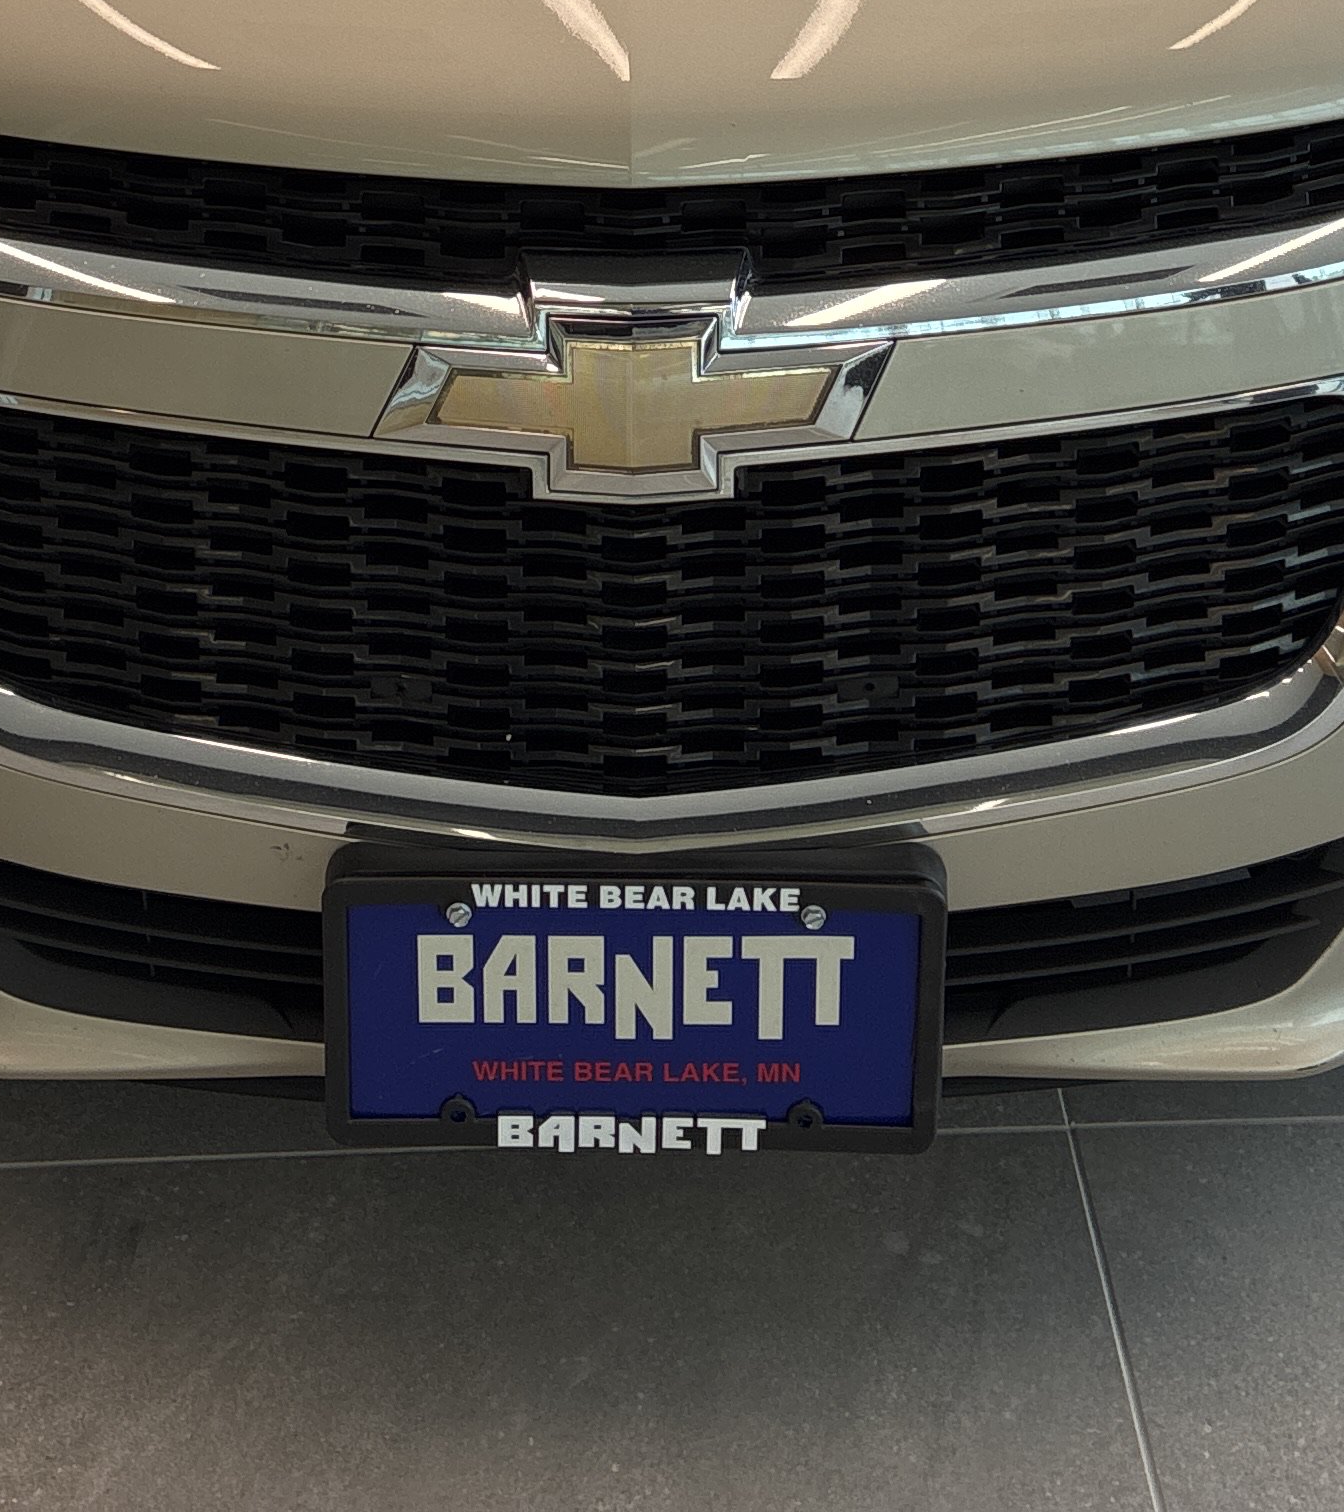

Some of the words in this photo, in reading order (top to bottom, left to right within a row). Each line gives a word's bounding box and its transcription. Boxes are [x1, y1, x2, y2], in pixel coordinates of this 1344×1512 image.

[471, 883, 588, 909] WHITE
[599, 885, 695, 910] BEAR
[706, 886, 802, 912] LAKE
[416, 934, 856, 1041] BARNETT
[472, 1061, 565, 1083] WHITE
[574, 1061, 654, 1083] BEAR
[663, 1062, 749, 1087] LAKE,
[757, 1063, 802, 1083] MN
[496, 1114, 768, 1156] BARNETT
